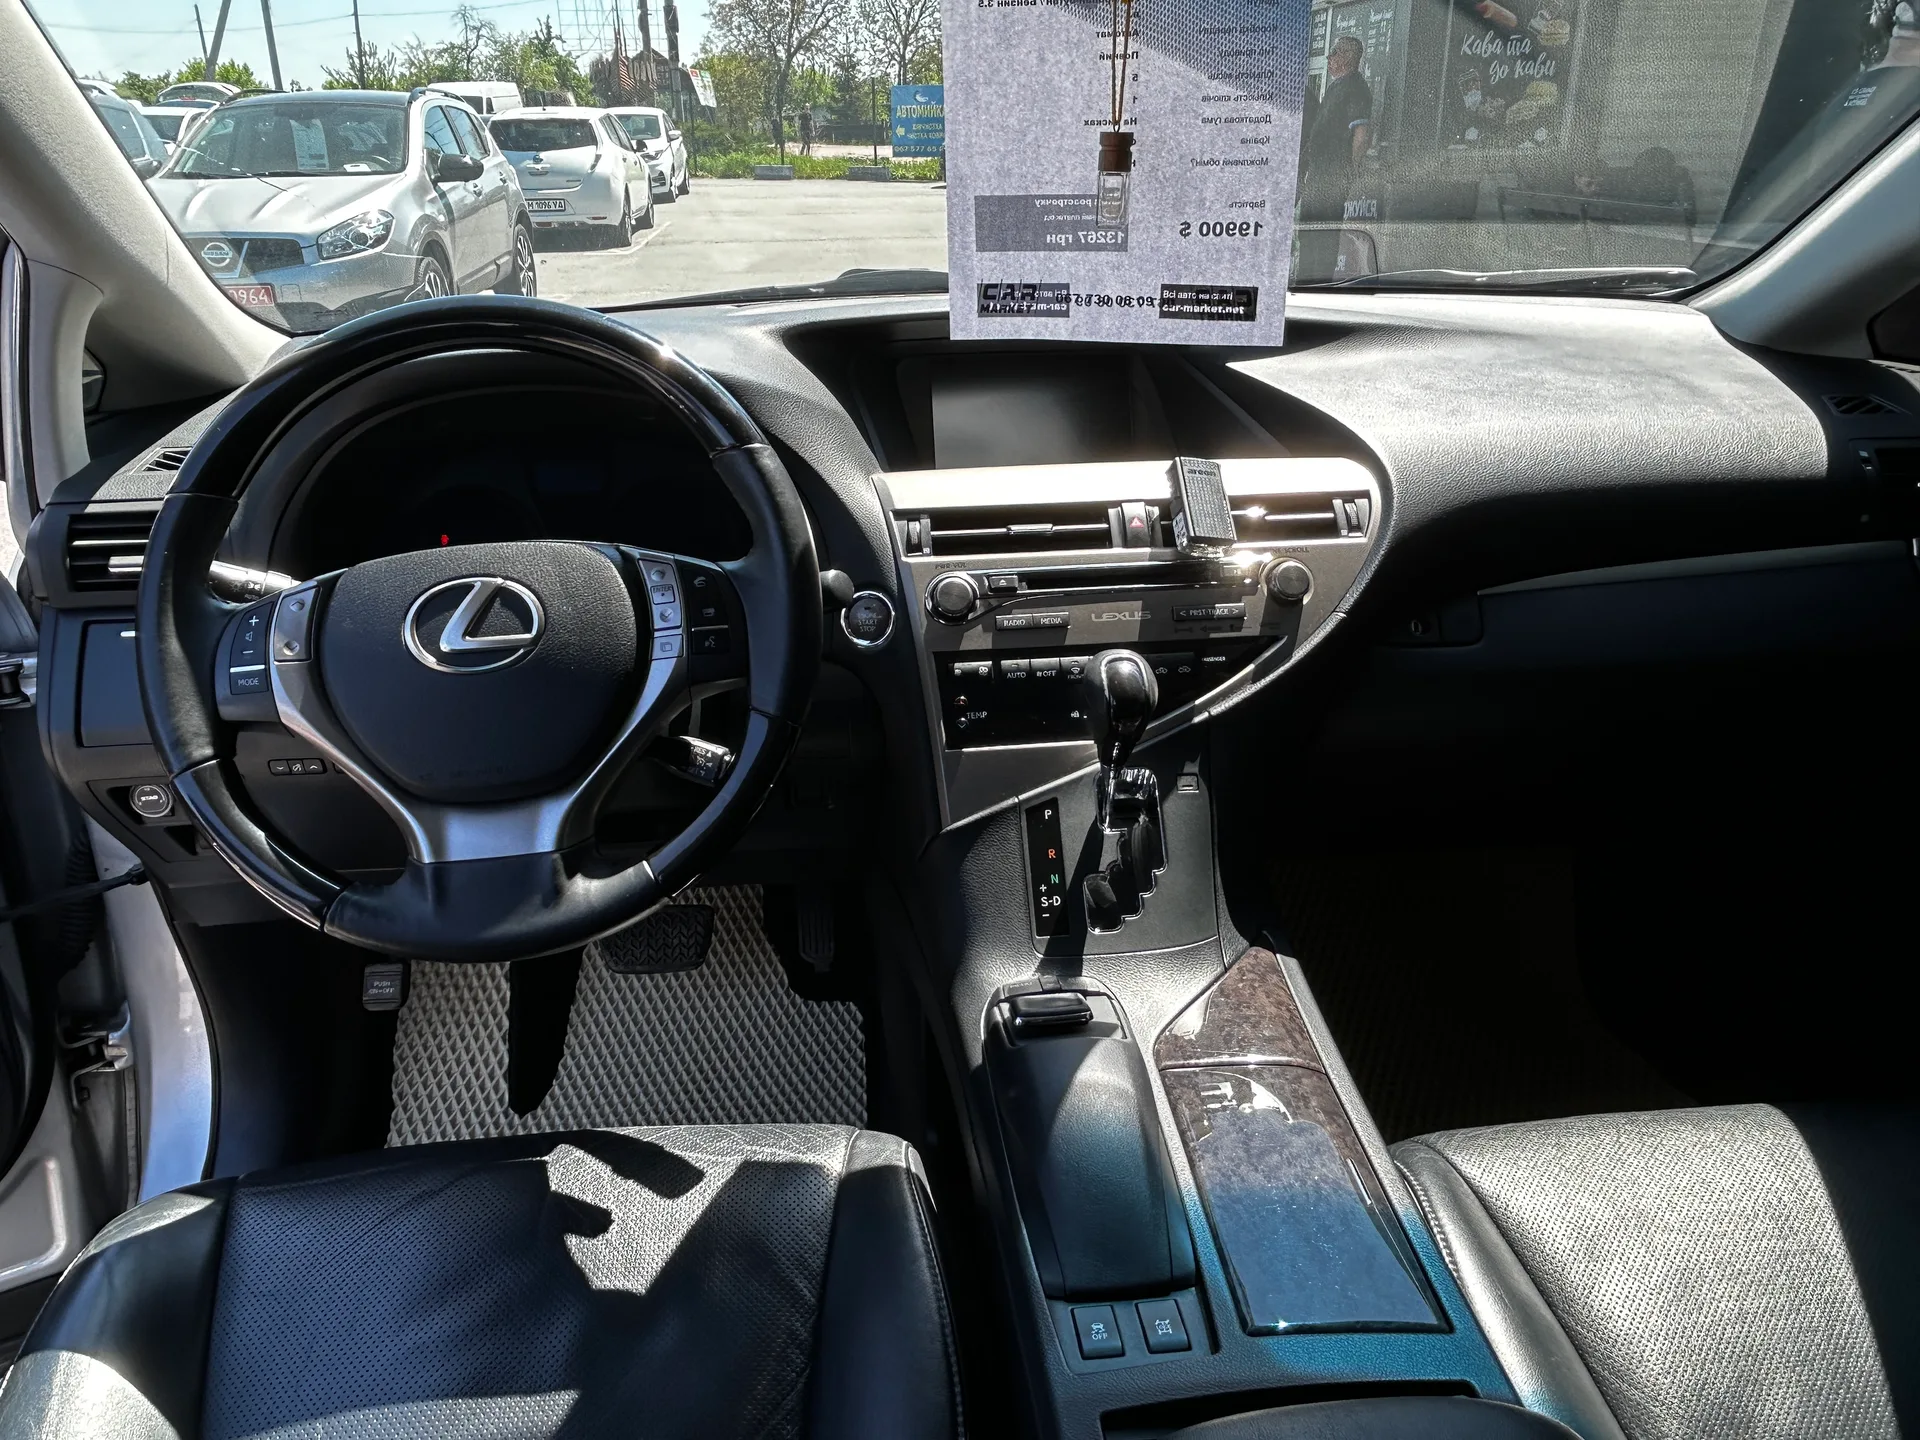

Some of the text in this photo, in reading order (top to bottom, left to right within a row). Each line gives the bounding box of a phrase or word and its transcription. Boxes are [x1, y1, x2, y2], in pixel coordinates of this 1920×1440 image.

[1461, 30, 1533, 57] Кава та
[1489, 52, 1556, 84] до кави
[896, 100, 945, 118] АВТОМИЙК
[1163, 290, 1176, 299] Всі
[1187, 468, 1216, 477] areon
[1091, 610, 1151, 622] LEXUS
[1003, 617, 1062, 627] RADIO MEDIA
[1006, 671, 1027, 679] AUTO
[1043, 669, 1057, 677] OFF
[238, 677, 259, 687] MODE
[966, 710, 988, 719] TEMP
[1044, 809, 1052, 820] P
[1048, 848, 1056, 859] R
[1051, 873, 1059, 884] N
[1091, 1332, 1108, 1341] OFF
